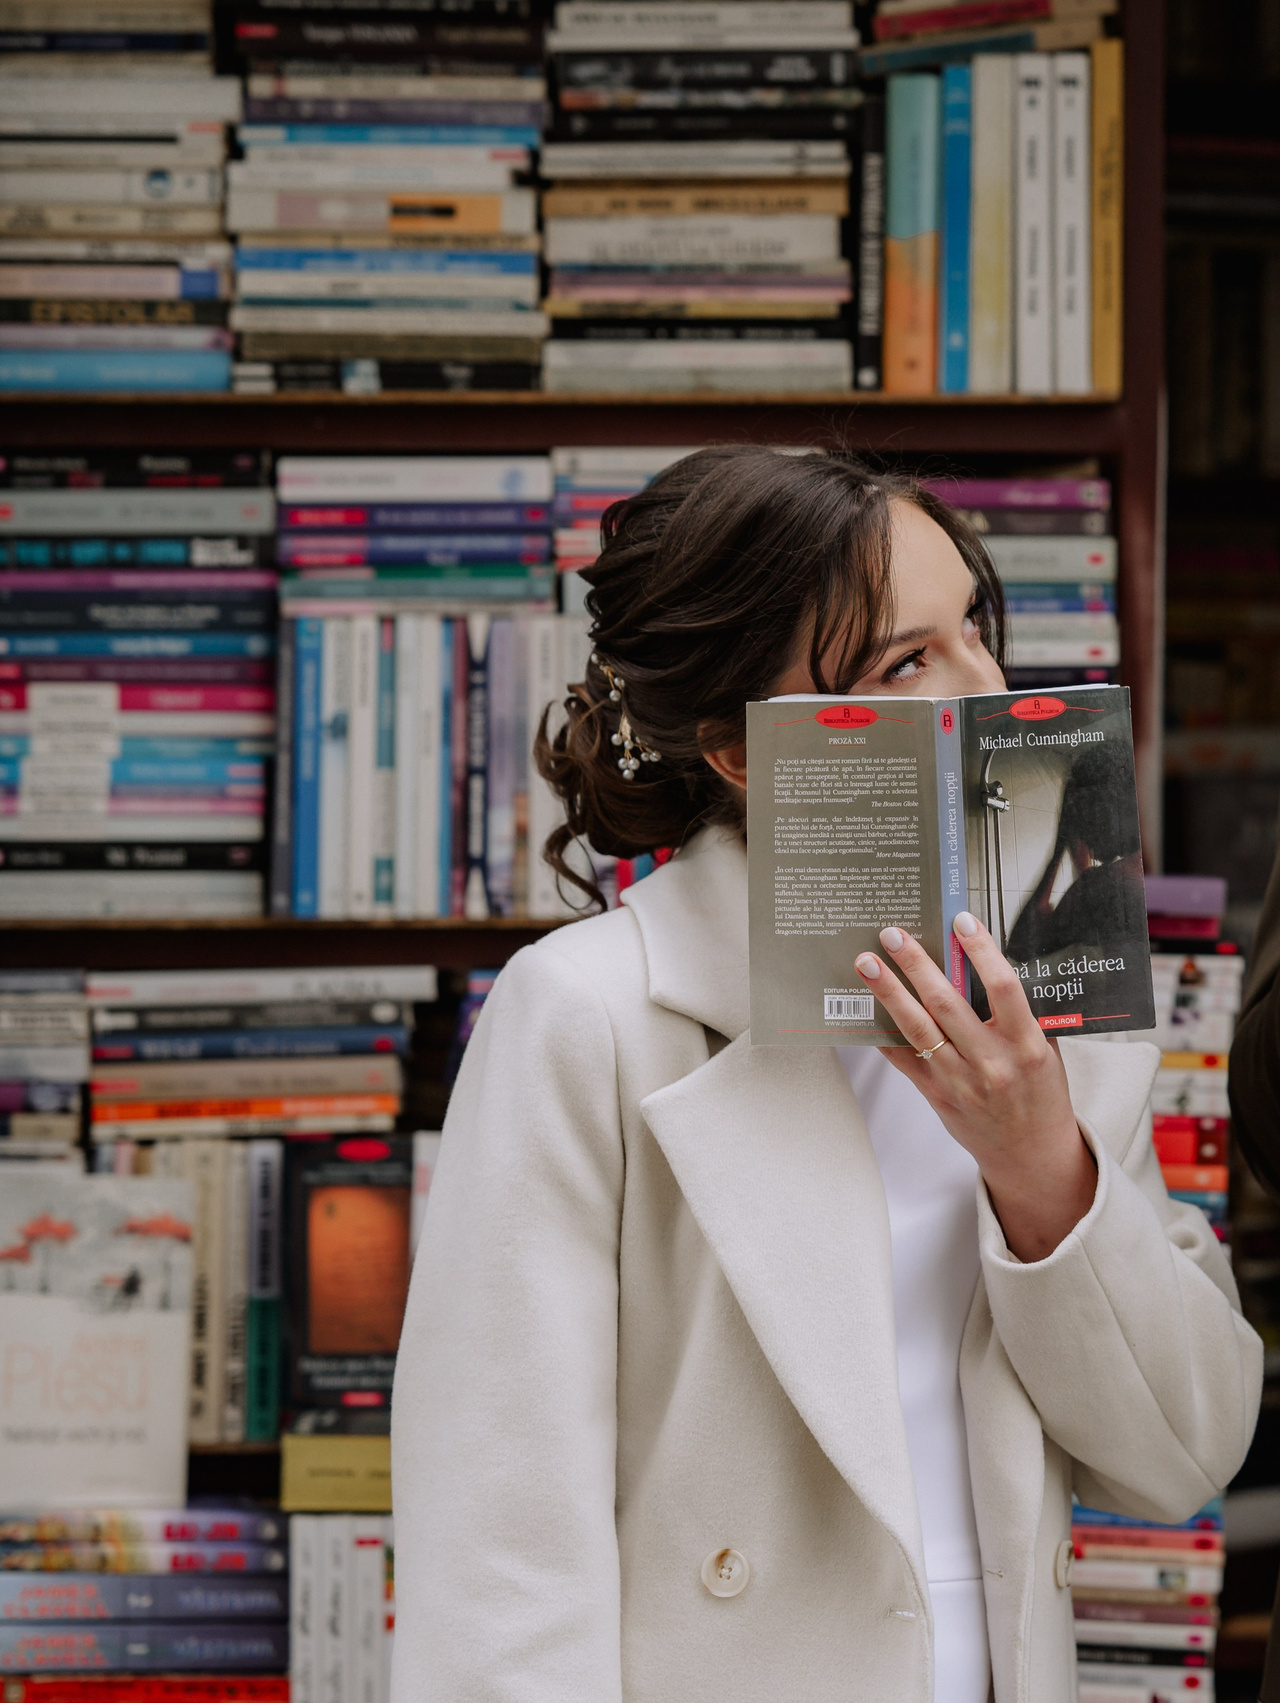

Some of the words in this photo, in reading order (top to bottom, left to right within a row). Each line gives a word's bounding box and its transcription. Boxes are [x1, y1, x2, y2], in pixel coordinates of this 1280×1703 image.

[828, 736, 852, 744] PROZĂ
[979, 733, 1022, 750] Michael
[1027, 729, 1105, 747] Cunningham
[946, 808, 957, 851] căderea
[948, 855, 958, 865] la
[949, 869, 960, 896] Până
[953, 938, 962, 985] Cunningham
[1013, 962, 1030, 979] nă
[1036, 960, 1051, 977] la
[1058, 956, 1125, 976] căderea
[1045, 1018, 1076, 1026] POLIROM
